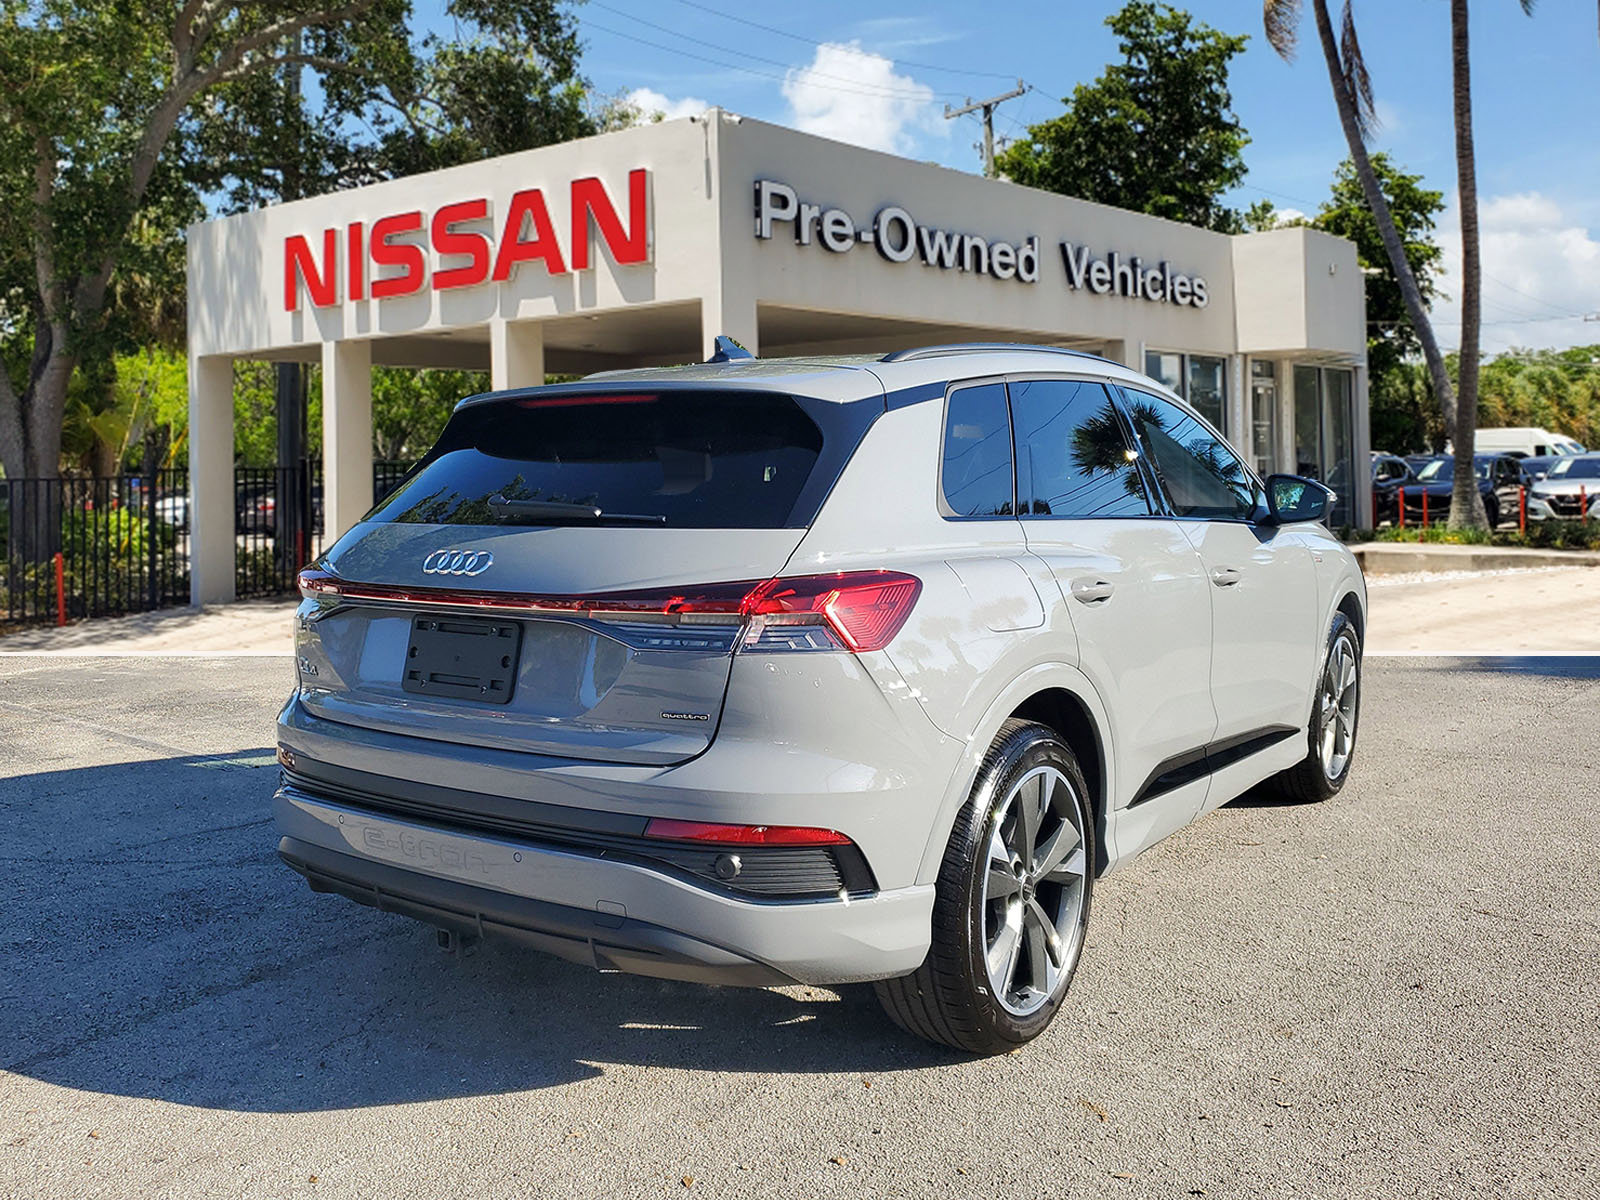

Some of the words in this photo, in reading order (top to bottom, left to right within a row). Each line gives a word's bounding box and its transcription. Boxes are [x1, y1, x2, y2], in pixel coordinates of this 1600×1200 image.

[285, 168, 648, 312] NISSAN
[755, 179, 1040, 284] Pre-Owned
[1060, 241, 1209, 309] Vehicles
[661, 711, 708, 721] quattro
[362, 826, 489, 874] e-tron
